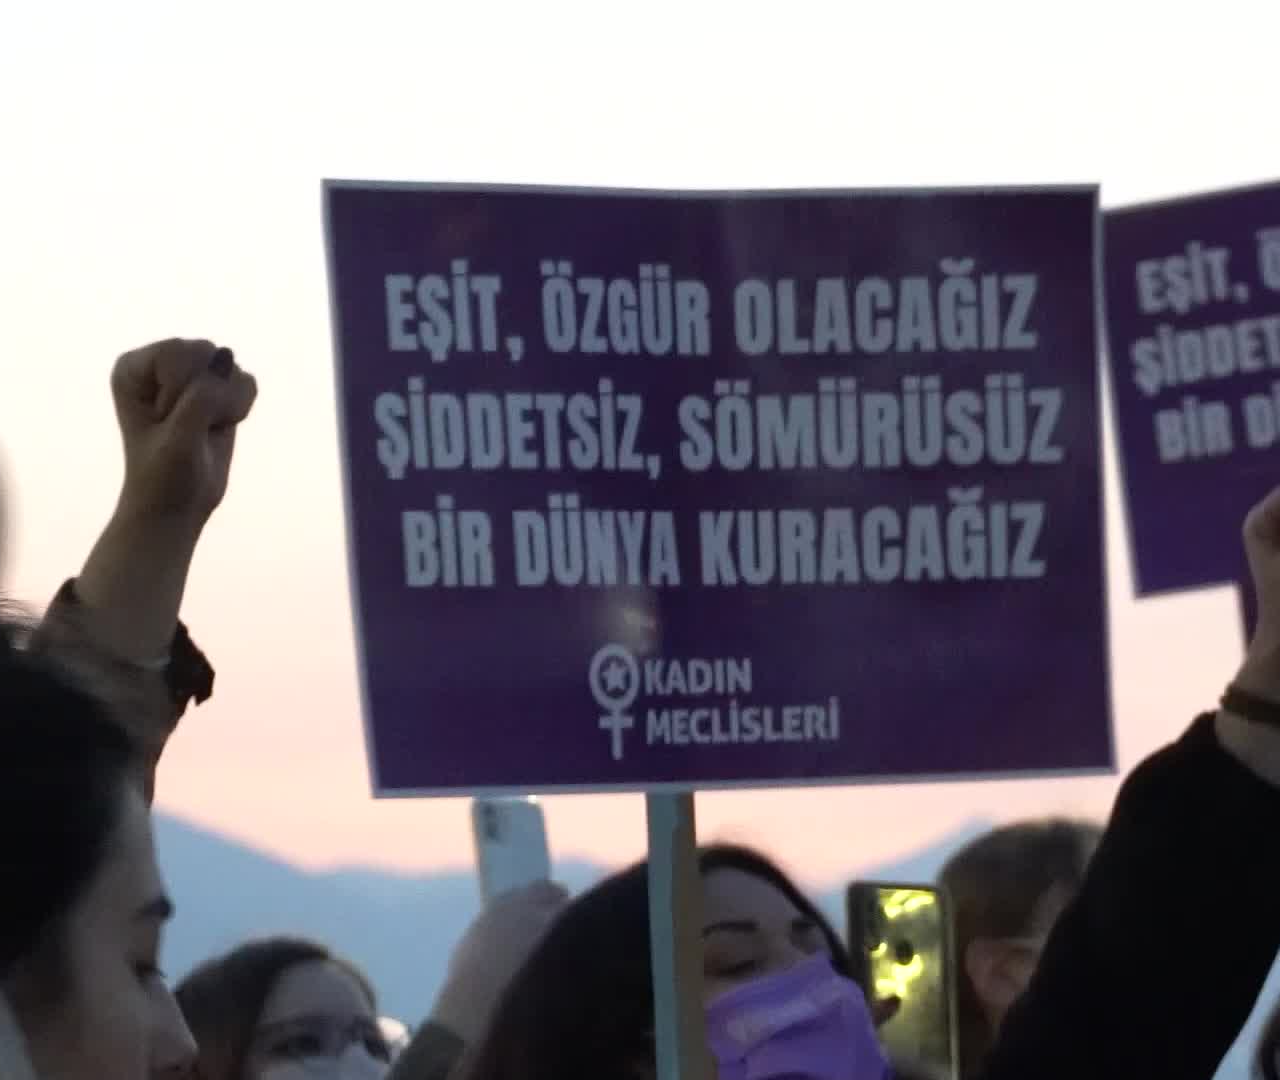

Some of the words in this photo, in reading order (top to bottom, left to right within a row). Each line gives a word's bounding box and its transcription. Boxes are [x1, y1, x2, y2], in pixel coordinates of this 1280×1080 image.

[385, 258, 524, 362] EŞİT,
[539, 260, 712, 356] ÖZGÜR
[734, 258, 1039, 356] OLACAĞIZ
[1136, 241, 1248, 316] EŞİT,
[373, 376, 662, 481] ŞİDDETSİZ,
[678, 372, 1065, 471] SÖMÜRÜSÜZ
[1154, 397, 1231, 463] BİR
[401, 494, 496, 588] BİR
[512, 493, 681, 587] DÜNYA
[699, 486, 1047, 587] KURACAĞIZ
[644, 657, 752, 696] KADIN
[646, 695, 840, 746] MECLİSLERİ
